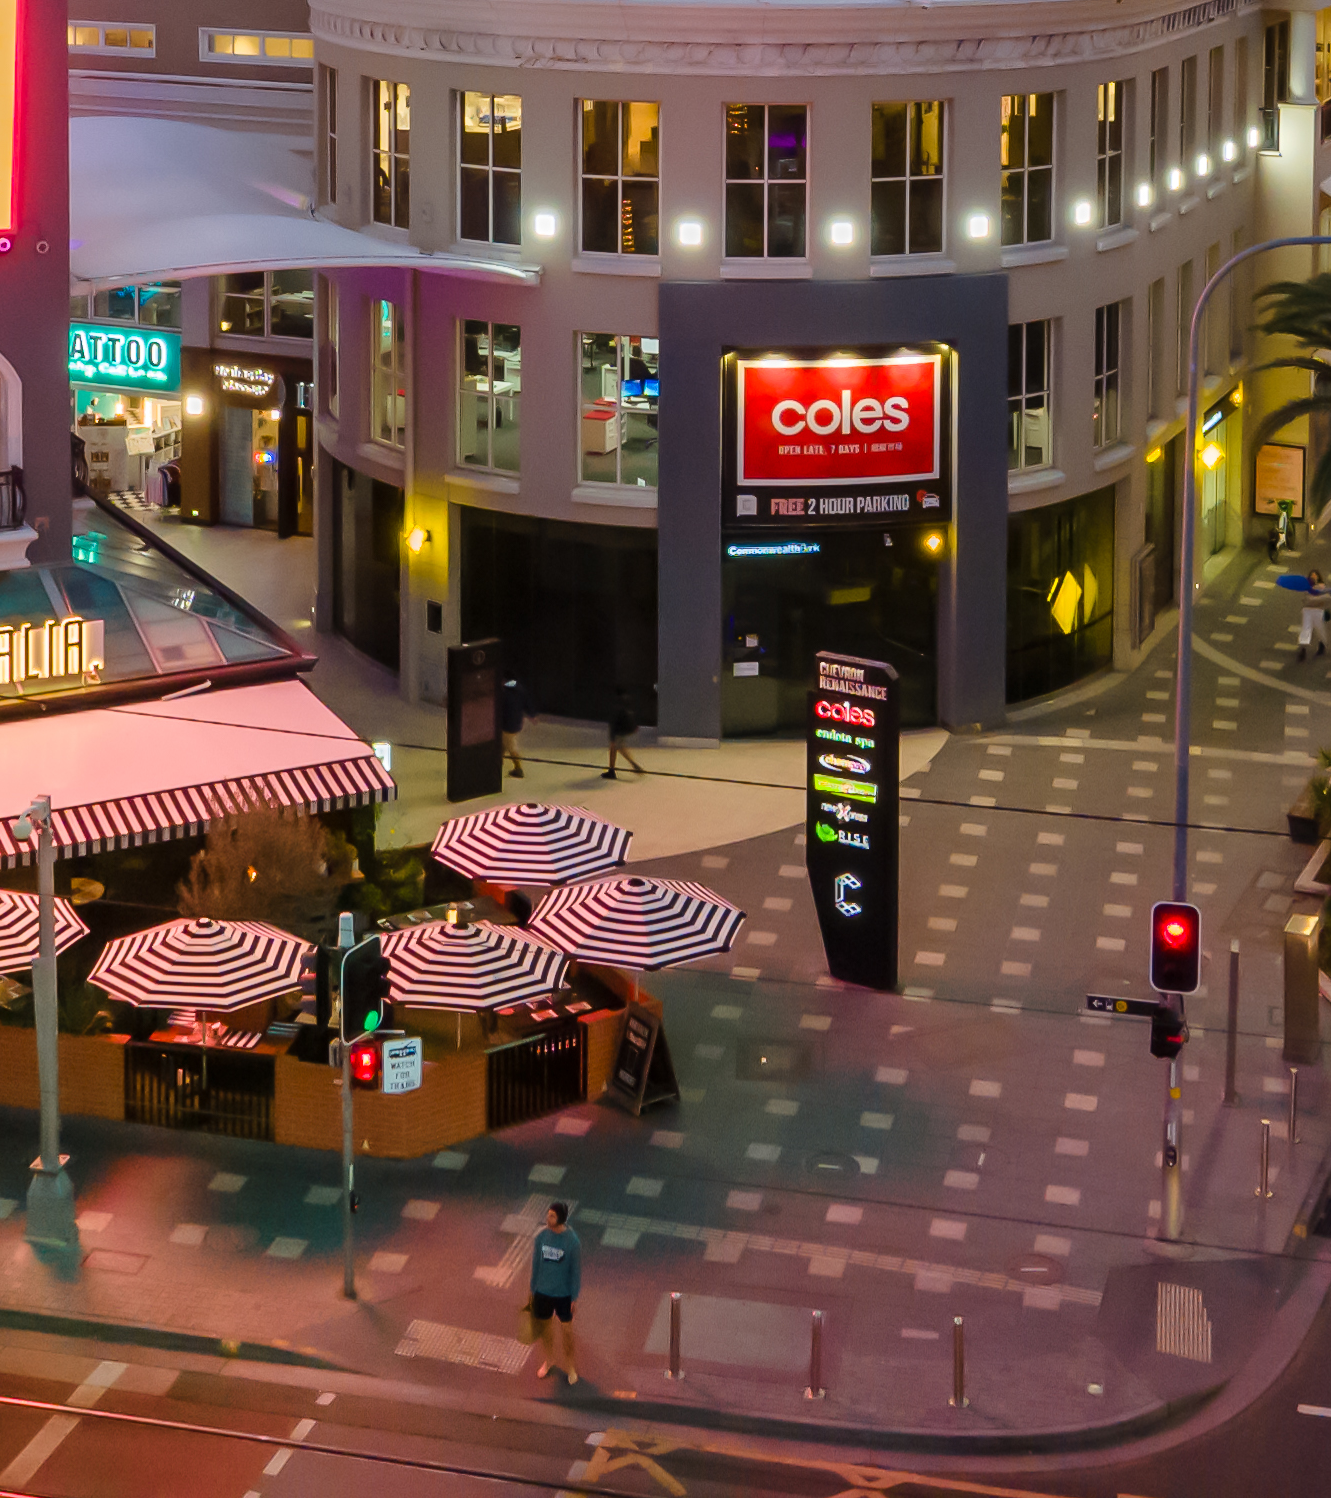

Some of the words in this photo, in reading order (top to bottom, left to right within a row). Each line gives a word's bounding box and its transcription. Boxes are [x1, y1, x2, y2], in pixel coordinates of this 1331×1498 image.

[771, 389, 910, 436] coles
[778, 445, 801, 455] OPEN
[829, 444, 836, 454] 7
[838, 444, 860, 454] DAYS
[770, 498, 806, 515] FREE
[807, 498, 816, 515] 2
[819, 497, 854, 514] HOUR
[856, 494, 910, 514] PARKING
[820, 662, 865, 682] CHEVRON
[820, 676, 887, 701] RENAISSANCE
[815, 701, 876, 728] coles
[390, 1061, 416, 1070] WATCH
[395, 1071, 410, 1080] FOR
